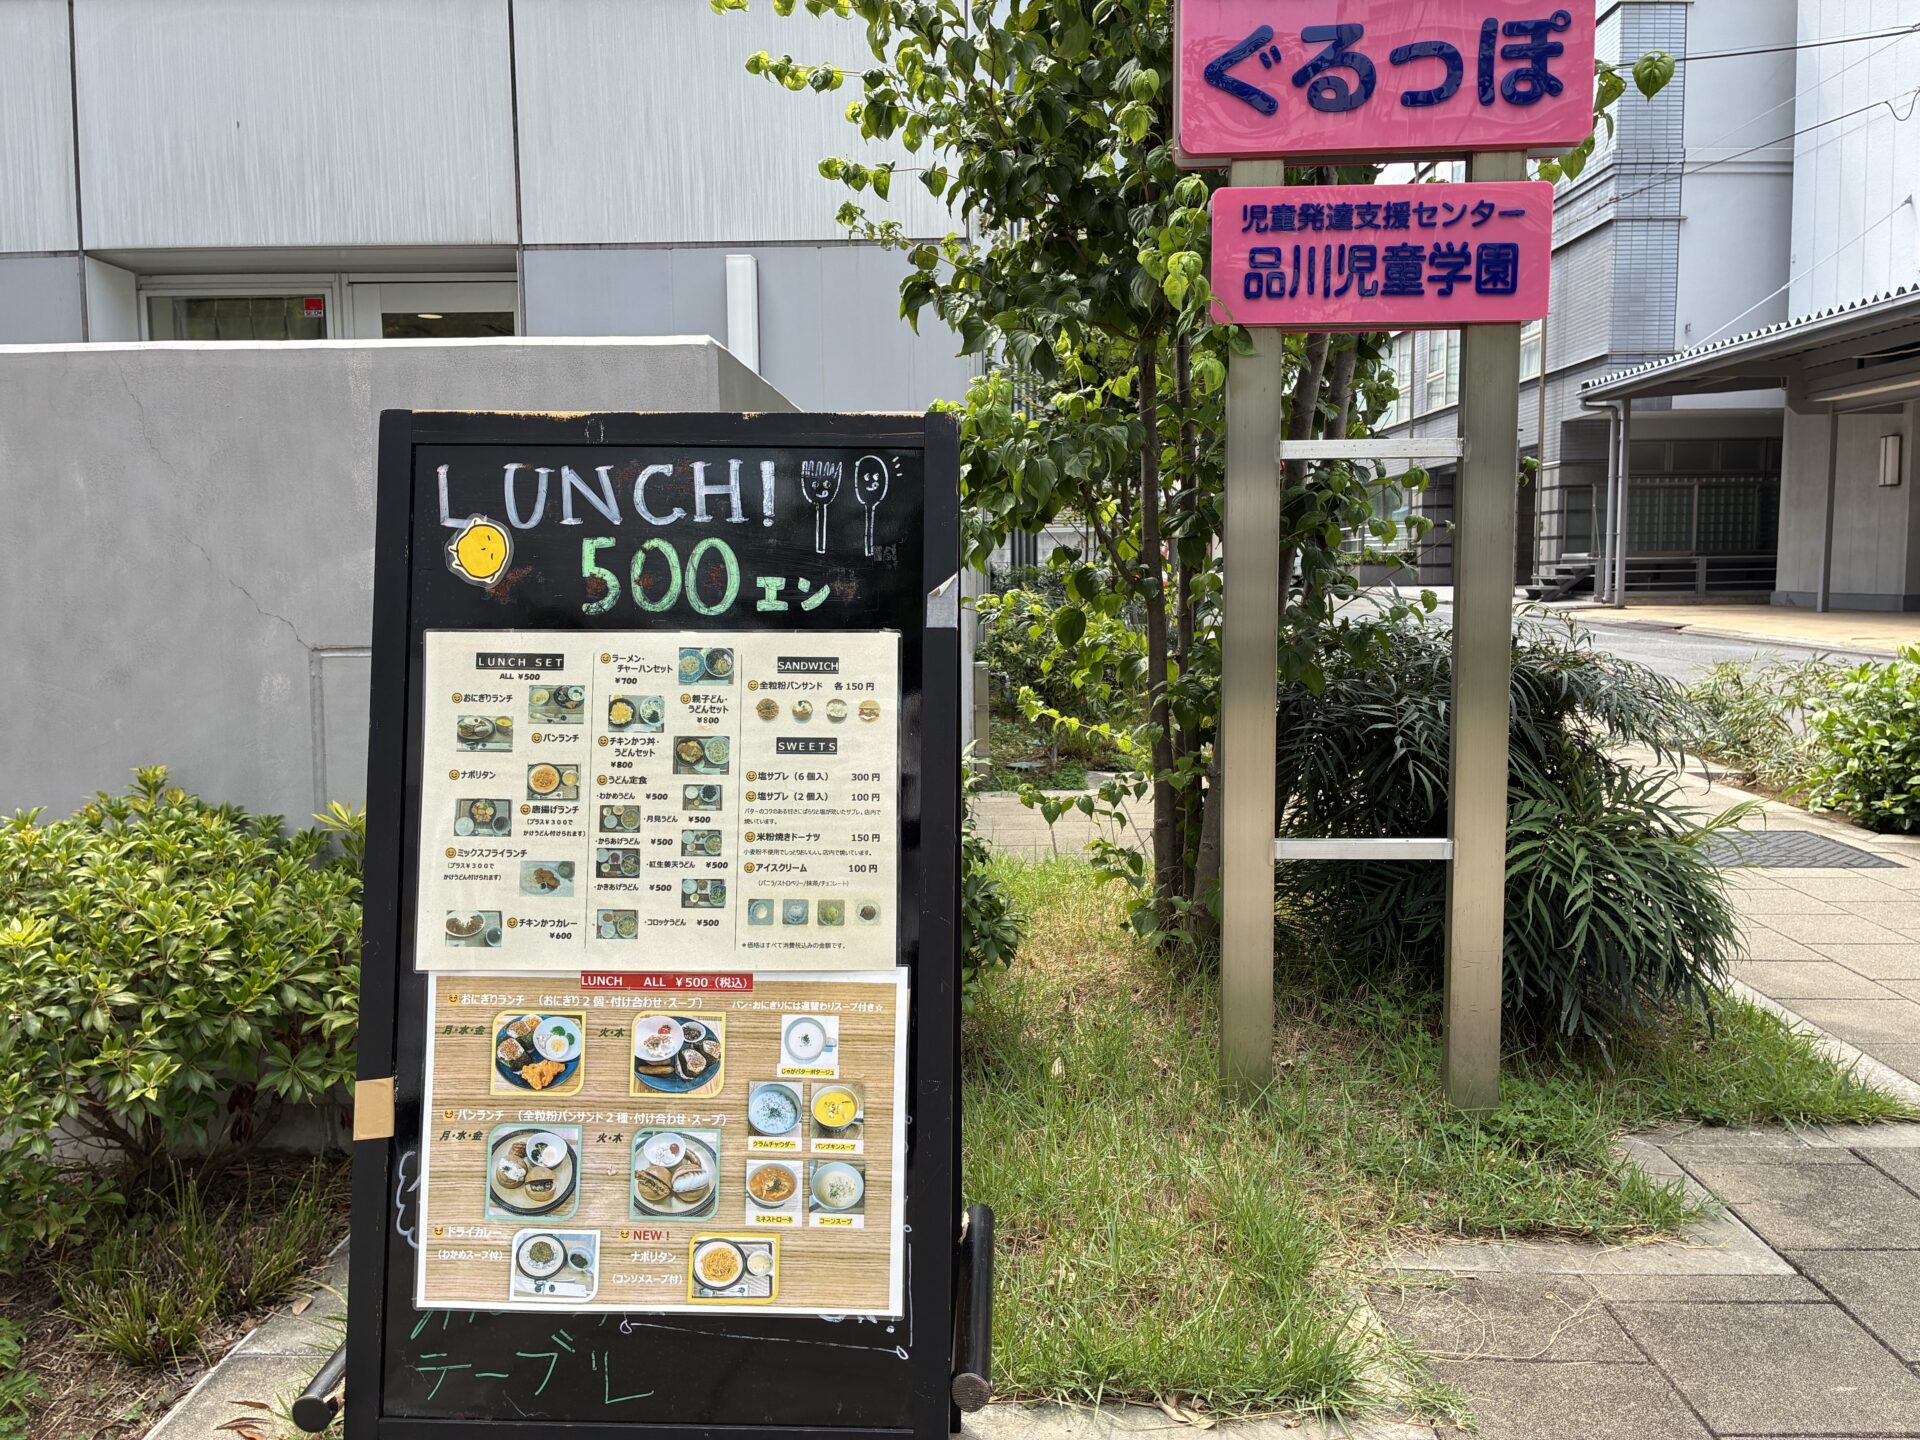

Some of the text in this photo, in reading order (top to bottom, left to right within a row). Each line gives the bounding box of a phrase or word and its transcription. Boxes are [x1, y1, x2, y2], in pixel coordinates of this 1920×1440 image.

[1203, 9, 1572, 116] ぐるっぽ
[1241, 199, 1526, 234] 児童発達支援センター
[1243, 240, 1520, 300] 品川児童学園
[436, 458, 776, 530] LUNCH!
[478, 656, 563, 669] LUNCH SET
[777, 661, 839, 671] SANDWICH
[616, 664, 674, 674] チャーハンセット
[499, 672, 541, 681] ALL ¥500
[614, 677, 638, 685] ¥700
[462, 693, 514, 704] おにぎりランチ
[687, 704, 730, 715] うどんセット
[542, 733, 580, 743] パンランチ
[777, 741, 837, 752] SWEETS
[613, 748, 656, 759] うどんセット
[610, 761, 634, 770] ¥800
[459, 769, 497, 780] ナポリタン
[607, 775, 648, 786] うどん定食
[645, 792, 669, 801] ¥500
[531, 804, 580, 816] 唐揚げランチ
[688, 816, 711, 825] ¥500
[650, 838, 674, 846] ¥500
[755, 832, 821, 843] 米粉焼きドーナツ
[456, 847, 529, 859] ミックスフライランチ
[705, 861, 729, 870] ¥500
[755, 863, 809, 874] アイスクリーム
[649, 884, 673, 893] ¥500
[518, 917, 579, 929] チキンかつカレー
[696, 919, 720, 927] ¥500
[549, 932, 573, 941] ¥600
[581, 976, 624, 987] LUNCH
[643, 976, 667, 988] ALL
[460, 994, 526, 1007] おにぎりランチ
[456, 1109, 506, 1122] パンランチ
[752, 1140, 797, 1149] クラムチャウダー
[815, 1142, 857, 1151] パンプキンスープ
[755, 1215, 794, 1224] ミネストローネ
[819, 1216, 854, 1225] コーンスープ
[447, 1225, 504, 1239] ドライカレー
[630, 1250, 678, 1264] ナポリタン
[415, 1328, 656, 1405] テーブル
